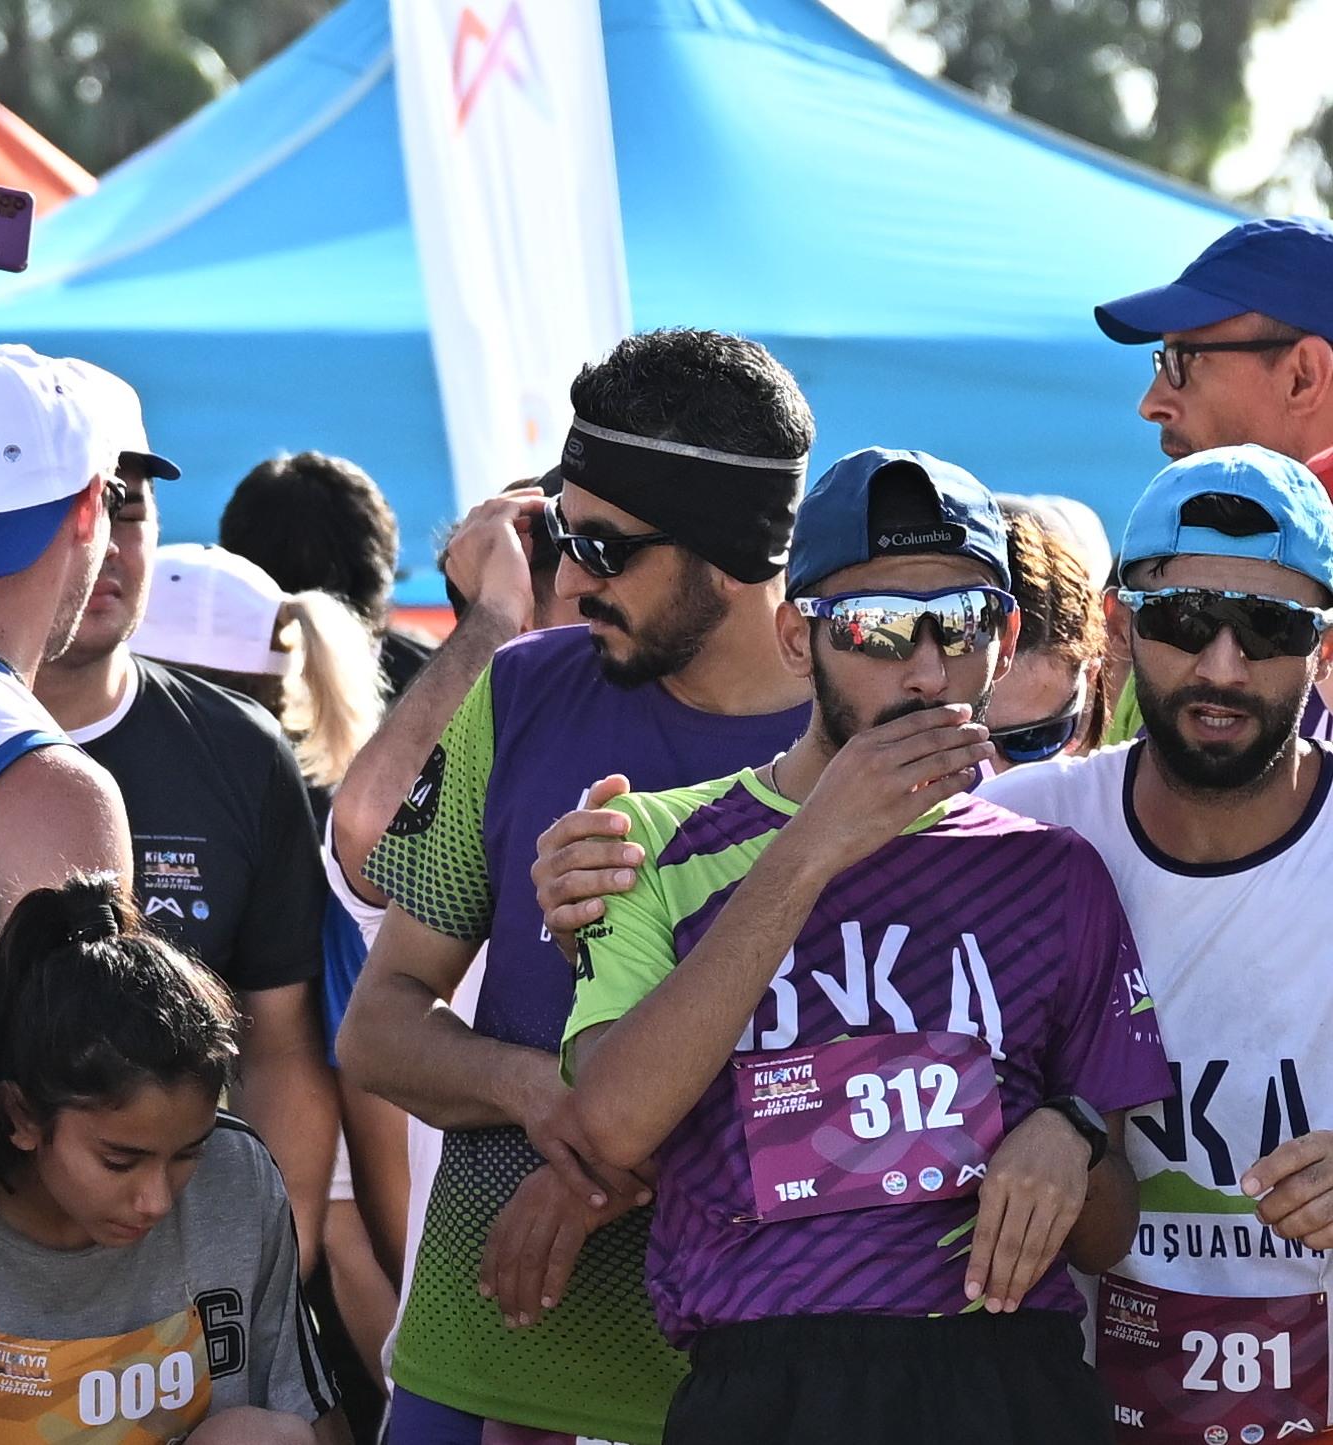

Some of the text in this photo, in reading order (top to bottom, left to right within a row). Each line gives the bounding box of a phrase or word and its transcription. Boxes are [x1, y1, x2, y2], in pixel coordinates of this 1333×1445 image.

[892, 530, 951, 546] Columbia
[753, 1100, 823, 1118] MARATONU
[767, 1096, 807, 1109] ULTRA
[845, 1064, 964, 1139] 312
[774, 1178, 818, 1202] 15K
[1137, 1223, 1326, 1263] OŞUADAN
[1104, 1328, 1160, 1349] MARATONU
[1116, 1324, 1148, 1339] ULTRA
[1182, 1330, 1291, 1393] 281
[0, 1379, 38, 1390] ULTRA
[78, 1350, 195, 1426] 009
